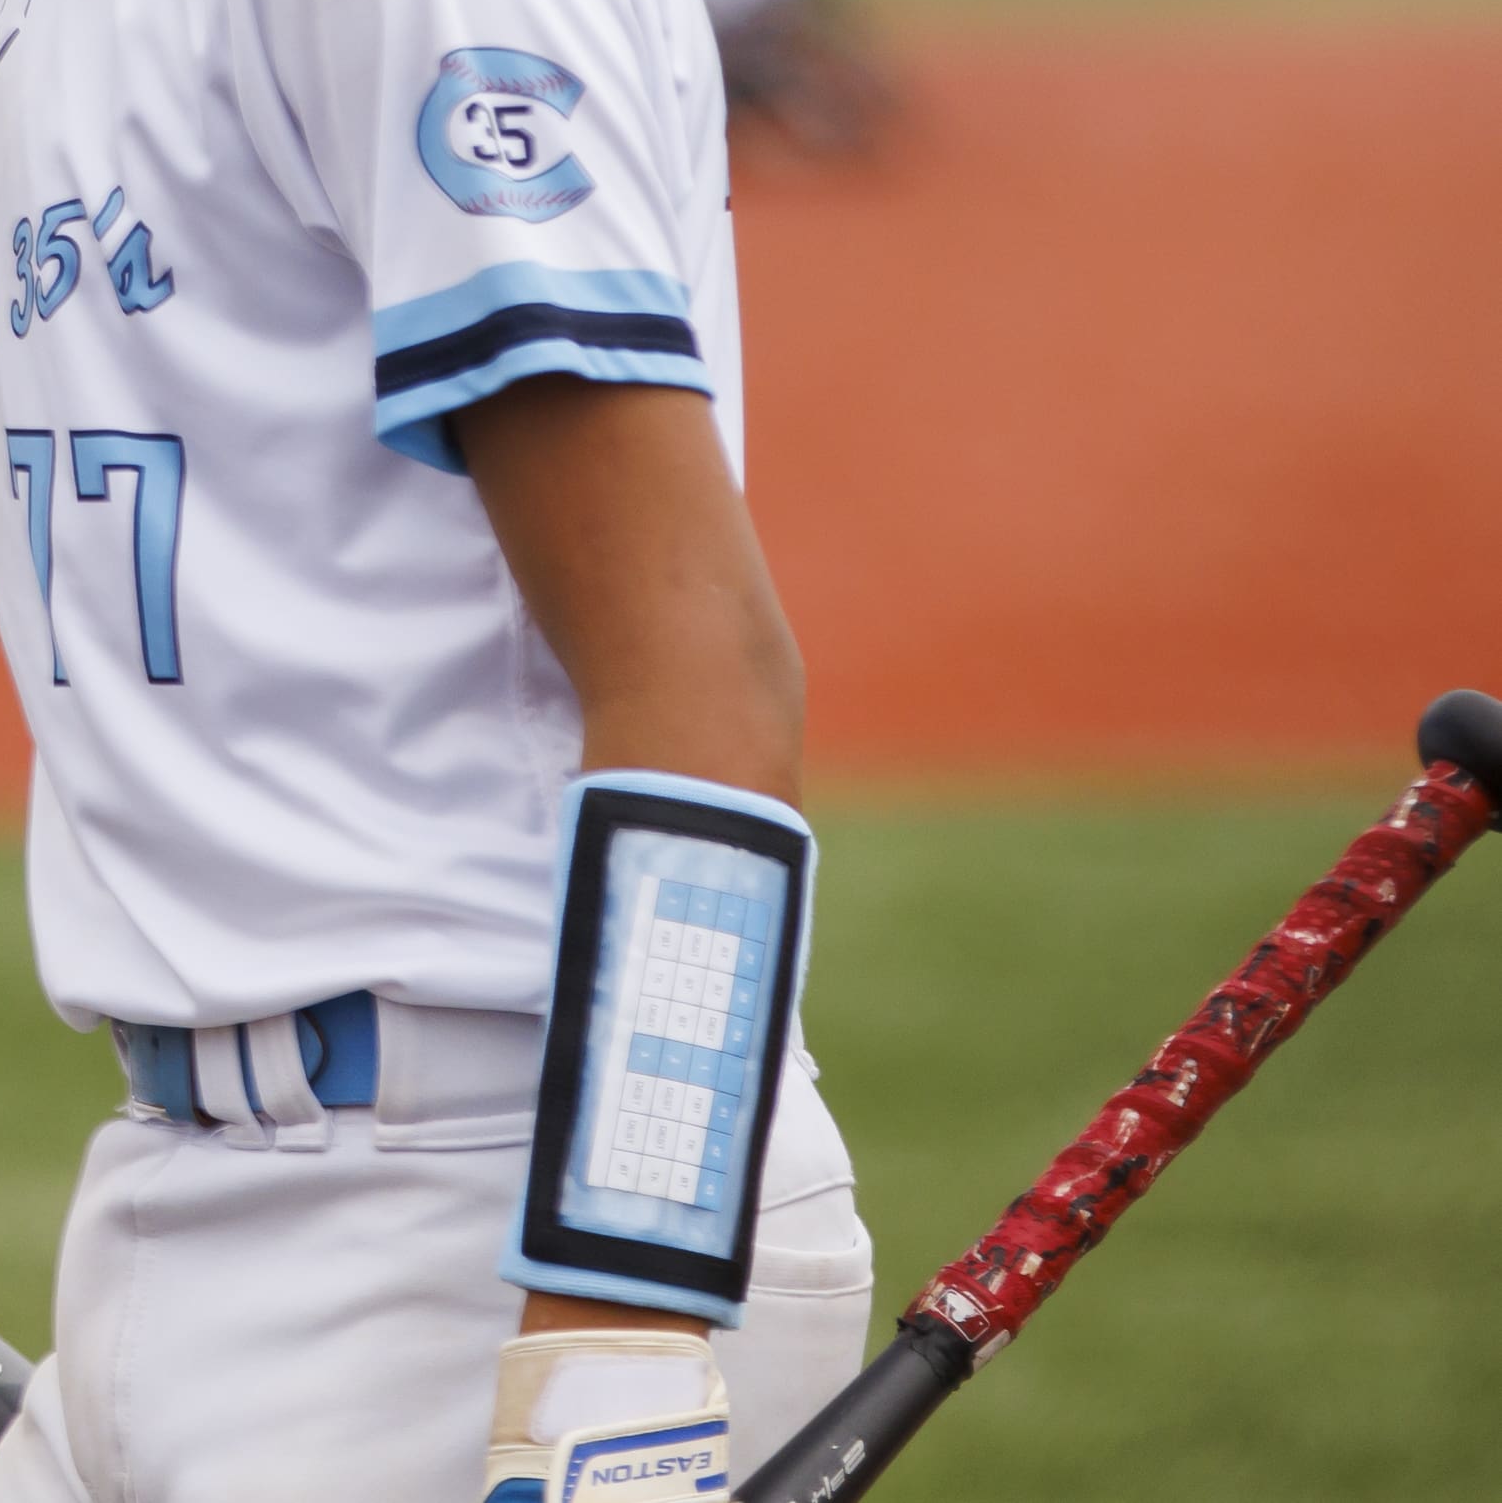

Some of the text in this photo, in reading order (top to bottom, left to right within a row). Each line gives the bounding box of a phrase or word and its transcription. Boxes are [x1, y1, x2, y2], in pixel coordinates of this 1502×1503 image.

[465, 101, 536, 169] 35
[3, 427, 187, 688] 77
[591, 1451, 713, 1487] EASTON
